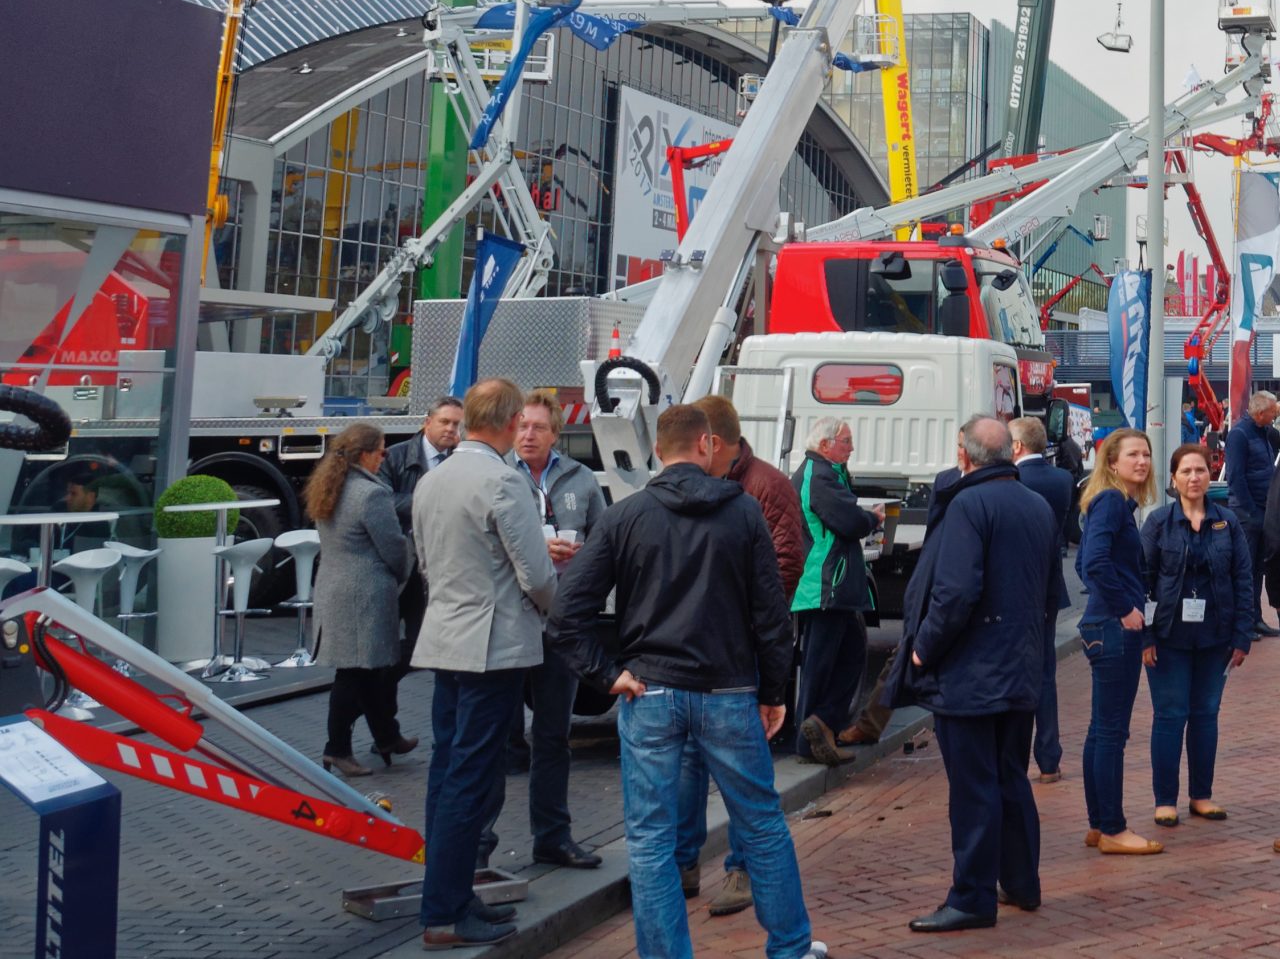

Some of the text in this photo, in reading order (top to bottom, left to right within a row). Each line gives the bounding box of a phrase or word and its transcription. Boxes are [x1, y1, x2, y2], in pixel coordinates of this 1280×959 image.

[1010, 7, 1032, 108] 01706 231942
[896, 72, 912, 141] Wagert
